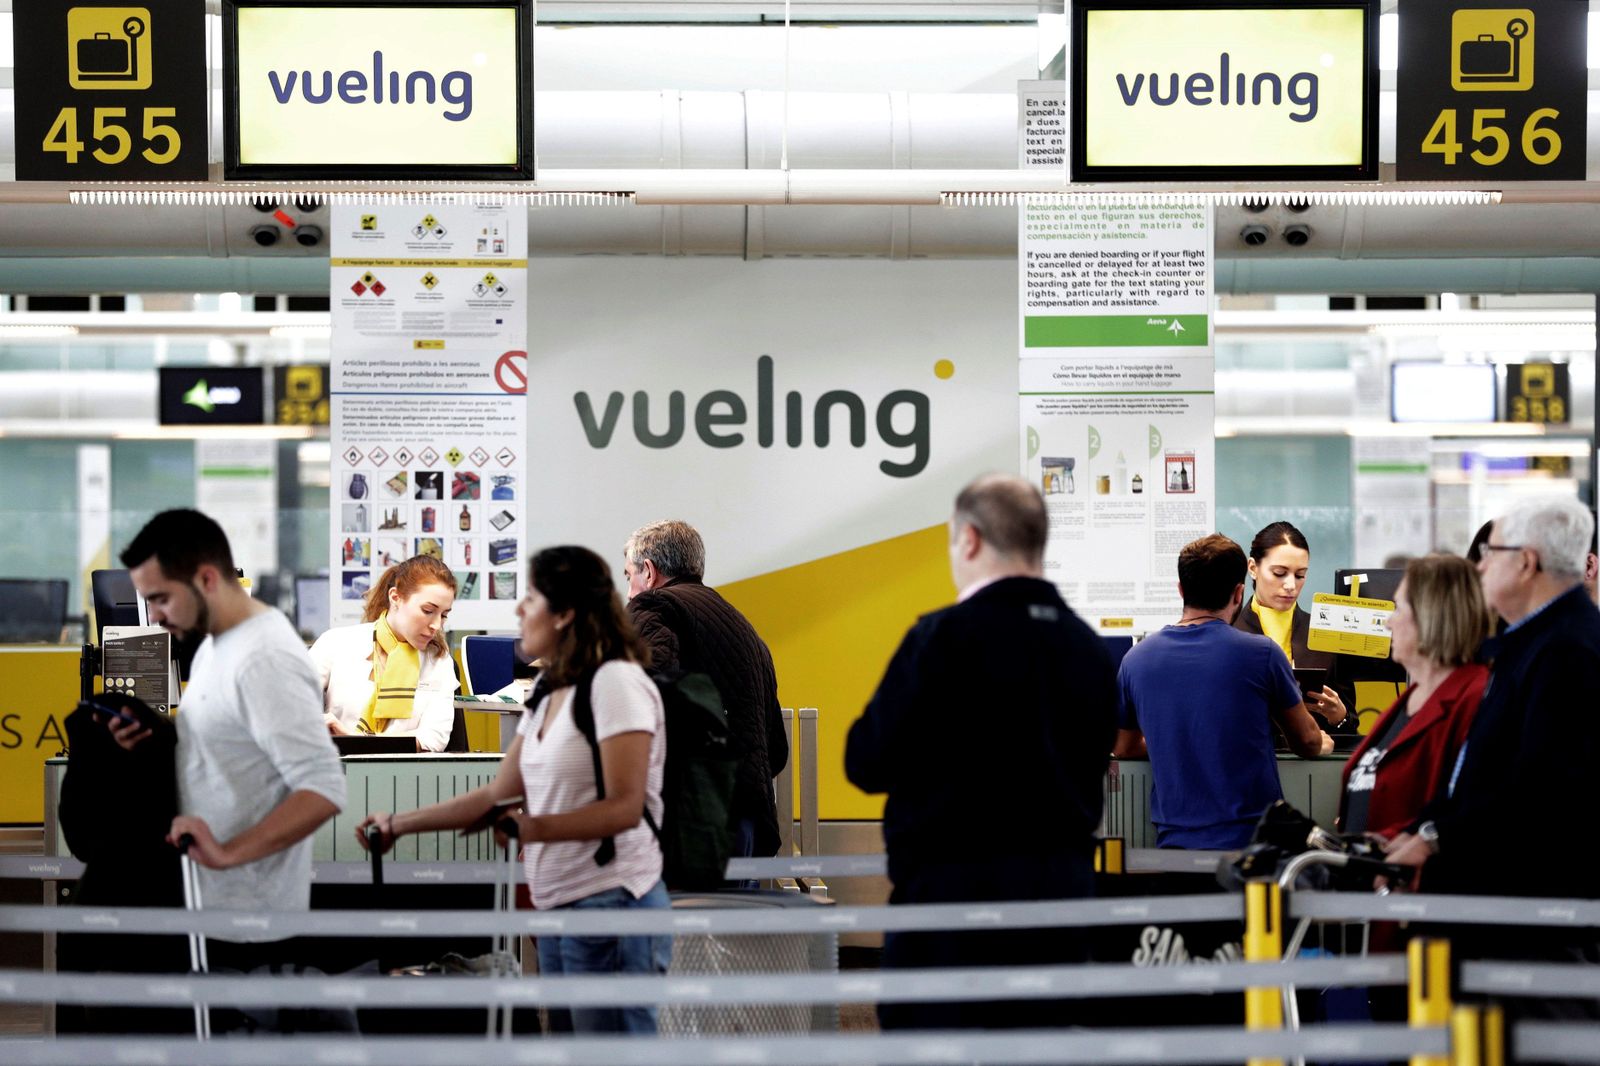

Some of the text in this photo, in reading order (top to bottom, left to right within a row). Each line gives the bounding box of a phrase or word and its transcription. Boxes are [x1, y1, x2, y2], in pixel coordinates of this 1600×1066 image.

[268, 50, 473, 122] vueling
[1116, 52, 1318, 123] vueling
[43, 108, 181, 164] 455
[1422, 108, 1562, 166] 456
[1080, 214, 1098, 222] que
[1101, 212, 1134, 222] figuran
[1100, 250, 1139, 259] boarding
[1182, 249, 1204, 258] flight
[1097, 260, 1132, 269] delayed
[1027, 280, 1068, 288] boarding
[1071, 280, 1091, 288] gate
[1149, 279, 1180, 288] stating
[1184, 280, 1204, 288] your
[1027, 290, 1059, 298] rights,
[574, 355, 930, 478] vueling
[1030, 436, 1036, 448] 1
[1091, 435, 1099, 448] 2
[1151, 435, 1160, 447] 3
[29, 863, 62, 874] vueling
